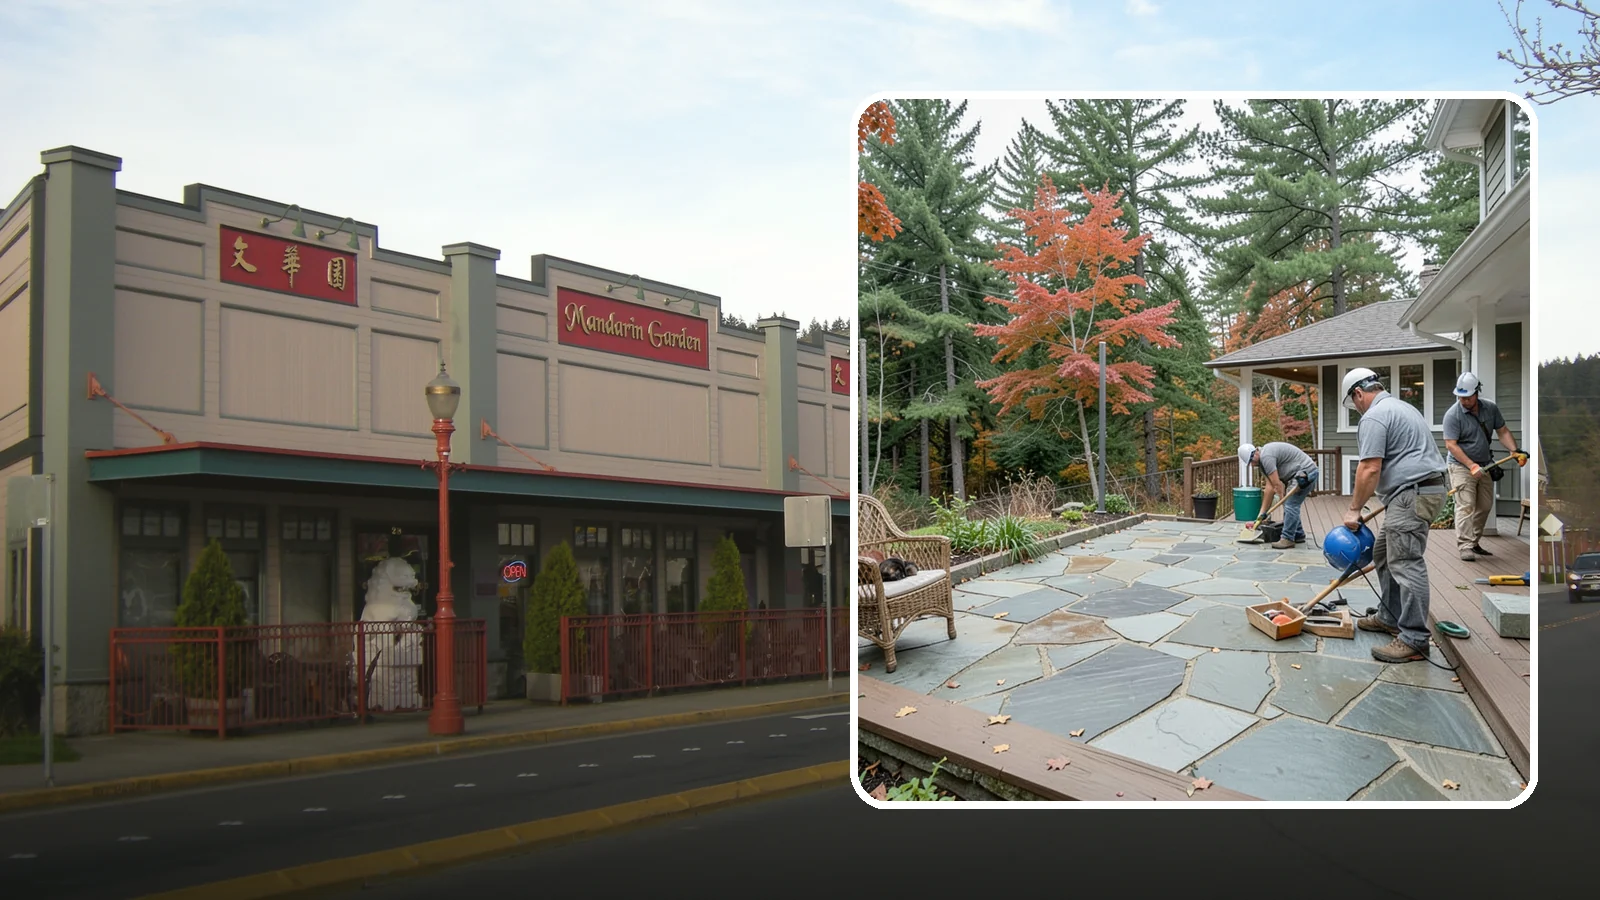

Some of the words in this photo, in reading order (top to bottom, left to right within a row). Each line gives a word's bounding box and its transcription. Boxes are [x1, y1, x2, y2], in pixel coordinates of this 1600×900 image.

[230, 236, 346, 291] 文華園
[564, 302, 644, 341] Mandarin
[647, 320, 701, 352] Garden
[834, 363, 846, 386] 文
[503, 565, 527, 578] OPEN
